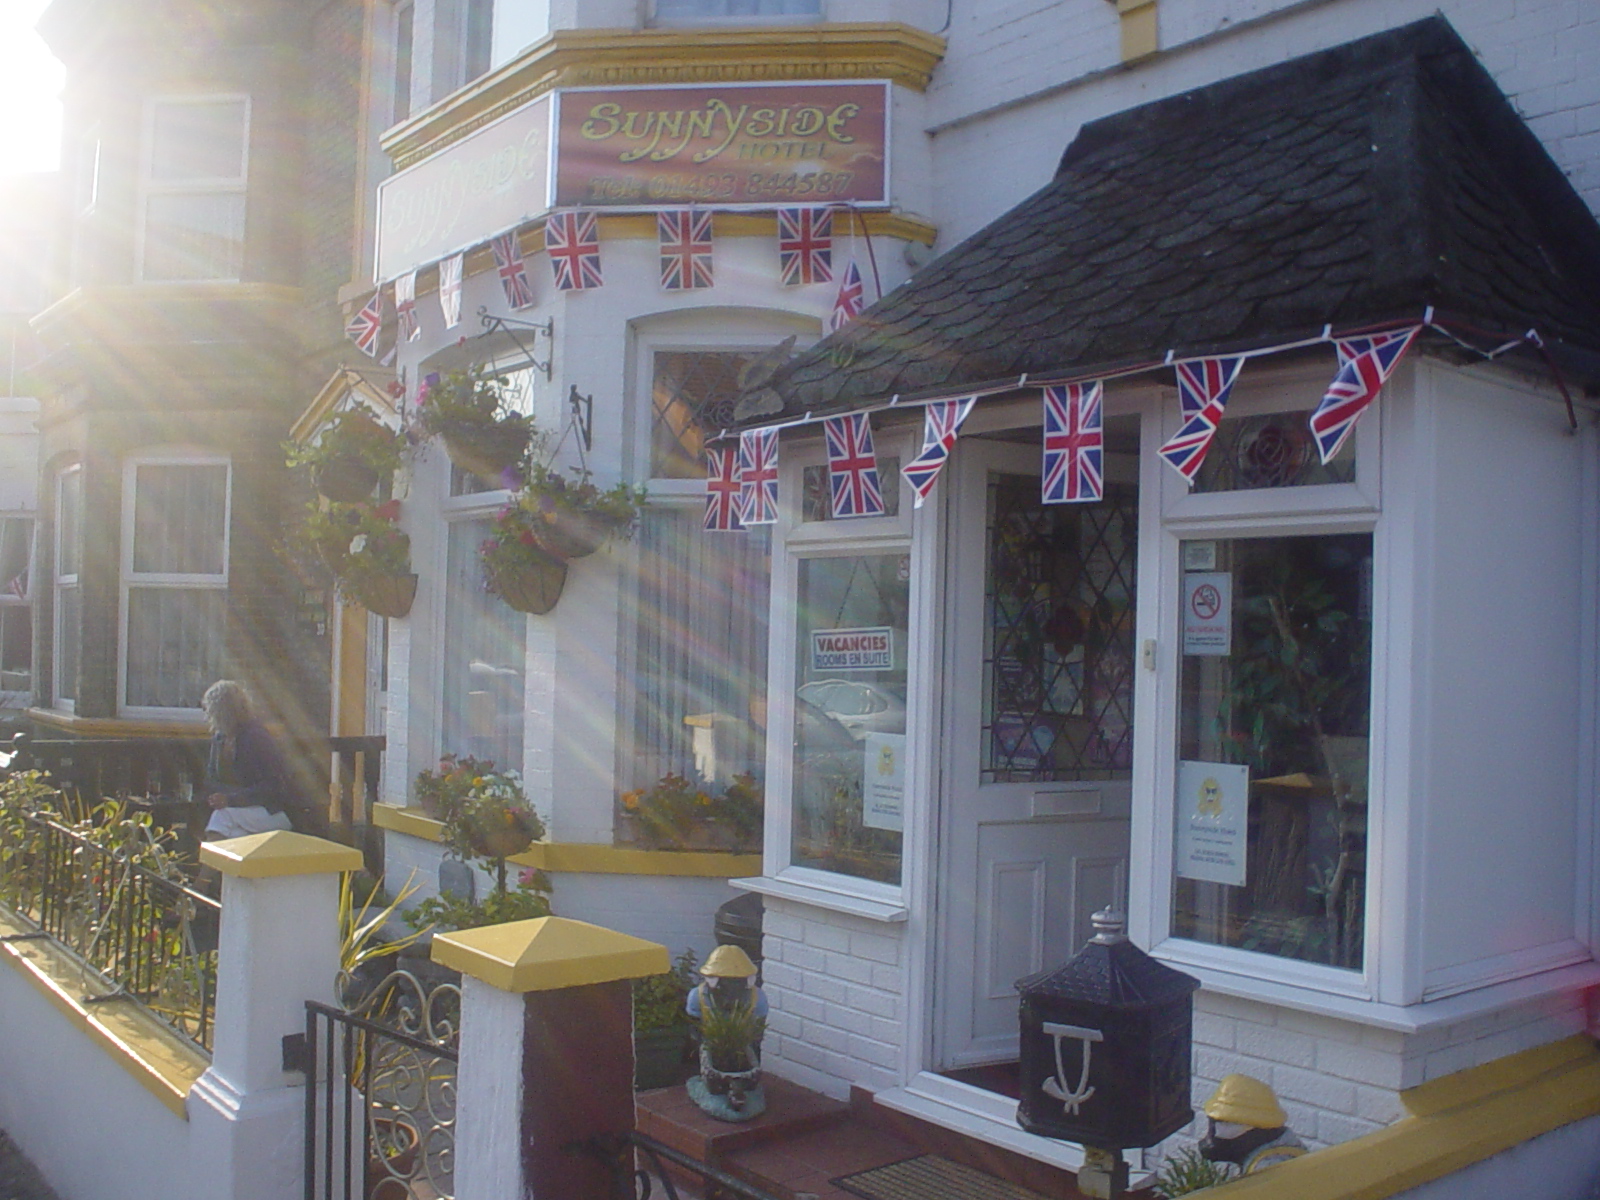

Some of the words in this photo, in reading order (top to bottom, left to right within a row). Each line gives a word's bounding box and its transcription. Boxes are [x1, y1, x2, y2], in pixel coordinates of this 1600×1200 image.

[738, 141, 832, 160] HOTEL
[746, 171, 855, 196] 844587
[817, 636, 887, 652] VACANCIES
[816, 652, 848, 666] ROOMS
[849, 653, 861, 665] EN
[863, 652, 888, 664] SUITE
